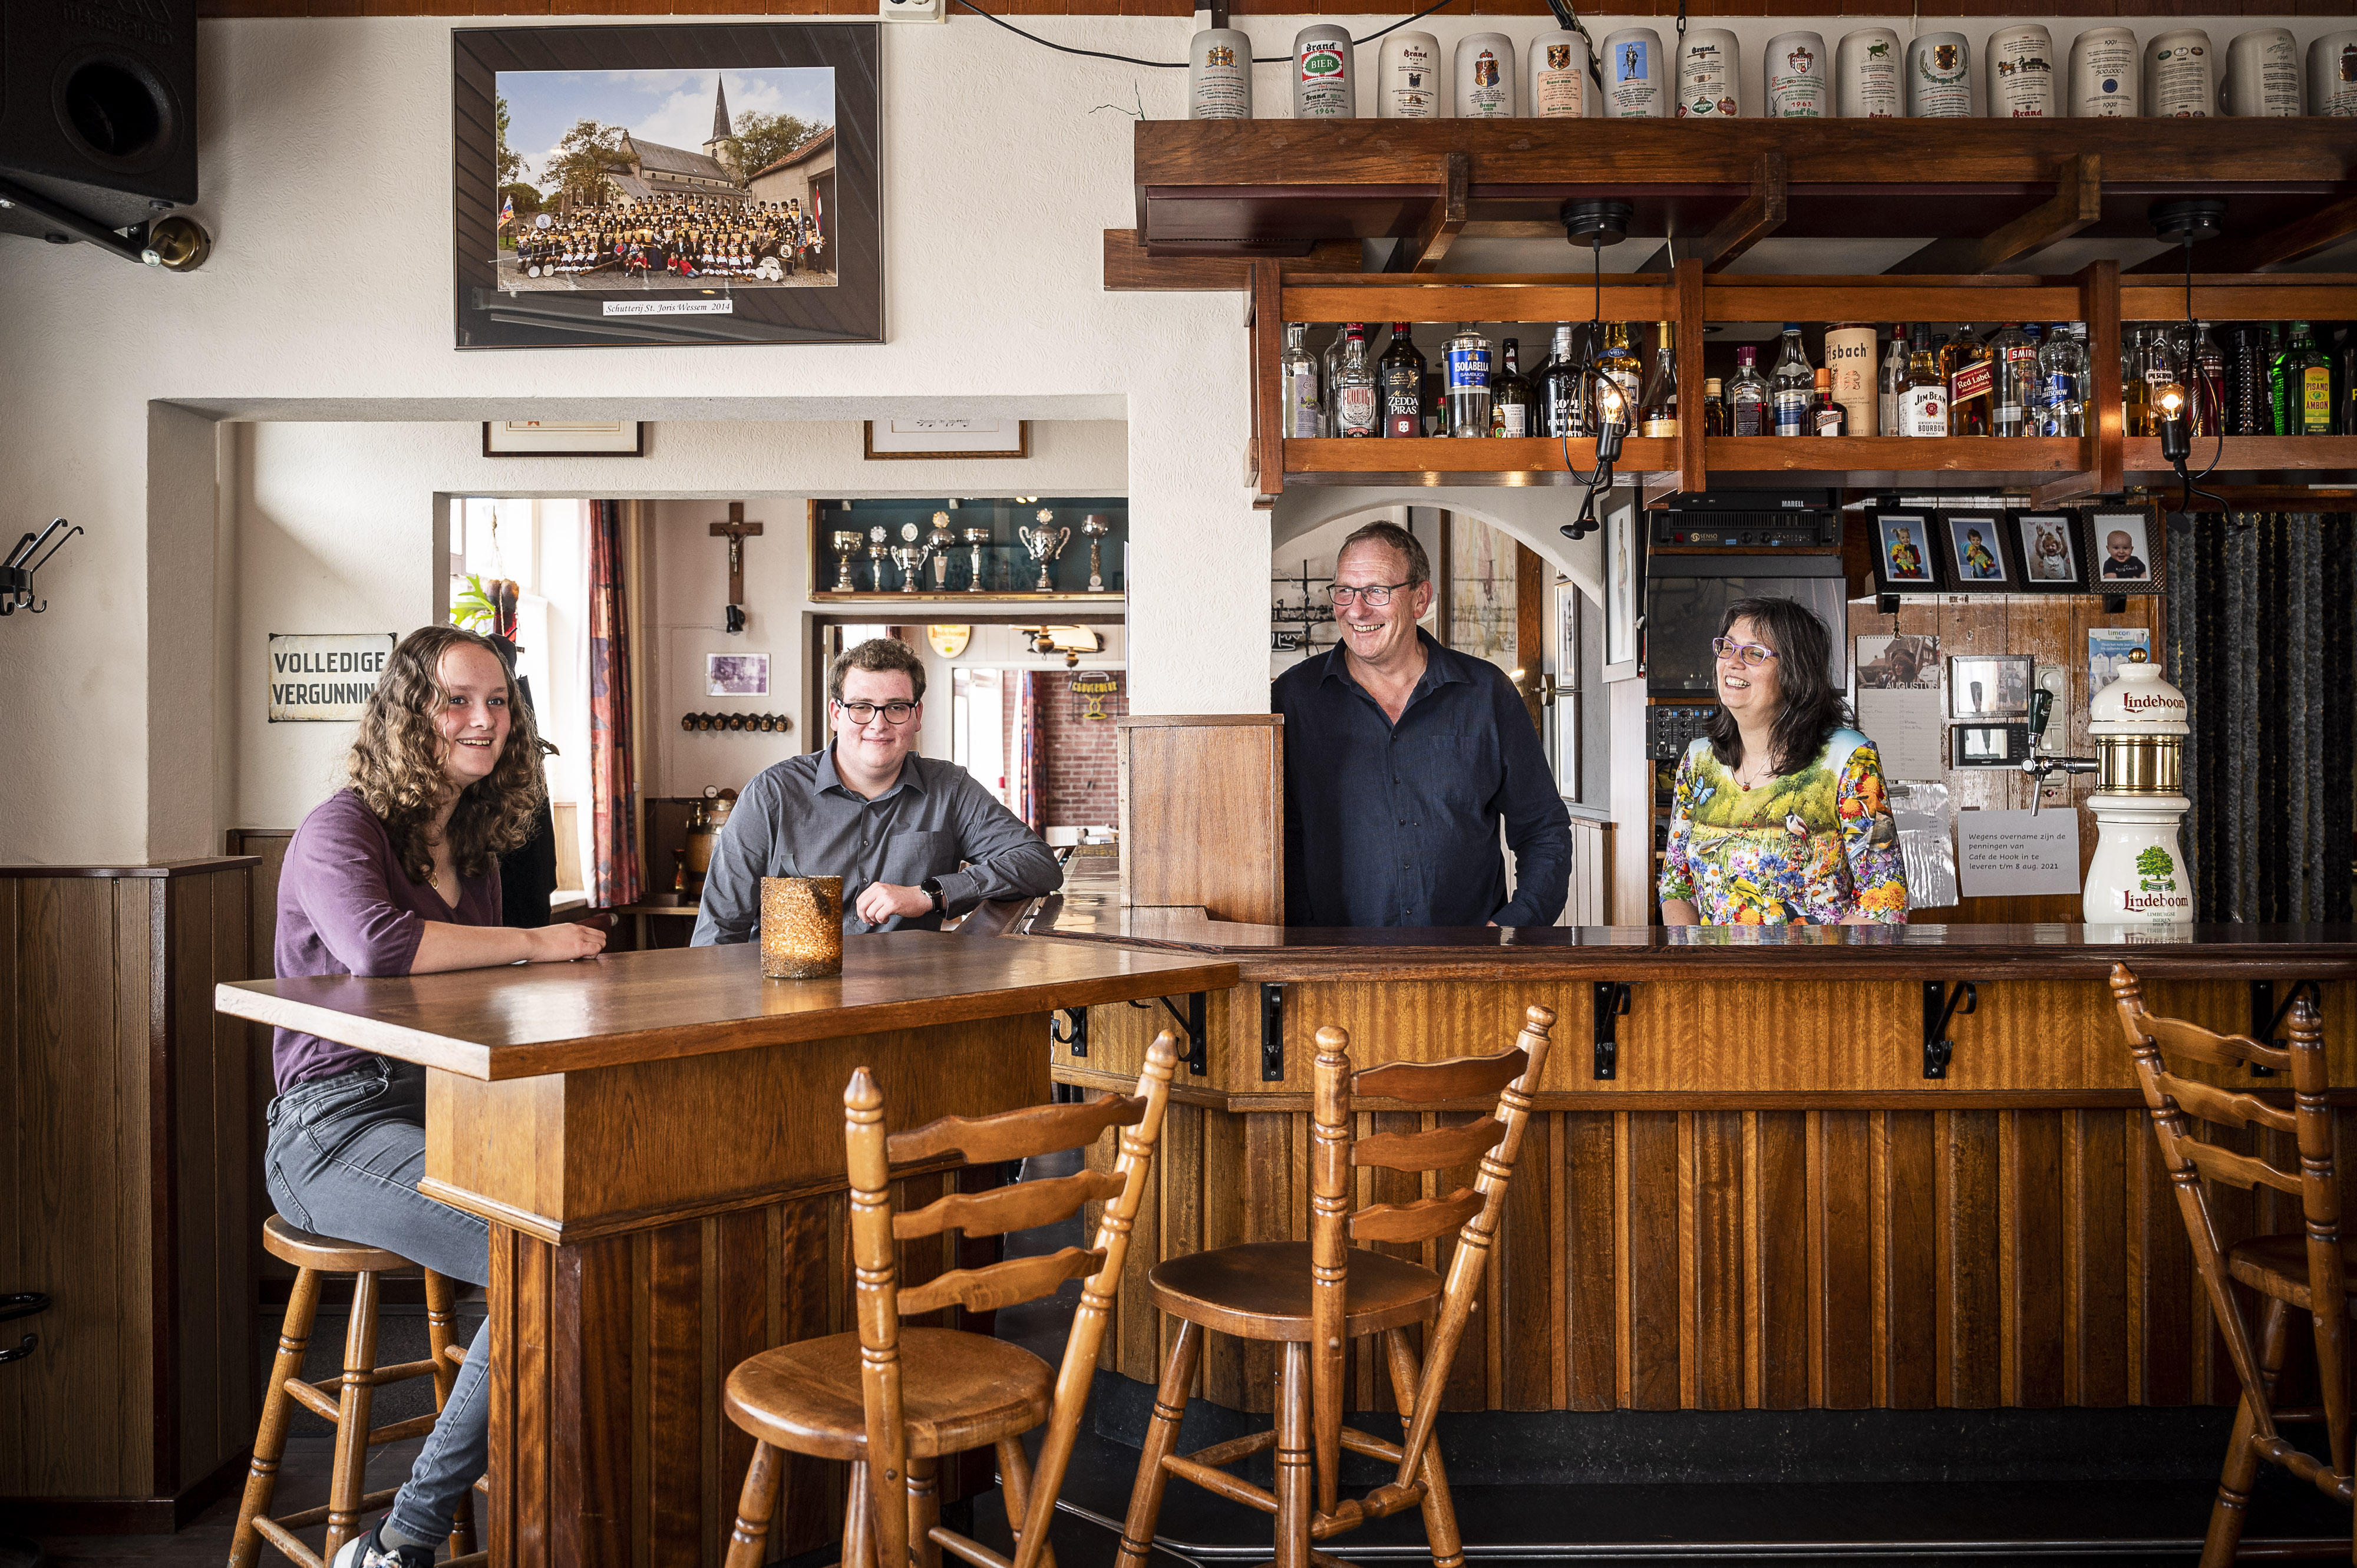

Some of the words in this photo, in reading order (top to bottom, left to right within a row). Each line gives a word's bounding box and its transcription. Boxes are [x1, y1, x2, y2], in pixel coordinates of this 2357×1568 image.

[1404, 49, 1427, 58] Brand
[1311, 60, 1333, 69] BIER
[1807, 108, 1818, 116] Bier
[2013, 109, 2042, 118] Brand
[606, 304, 643, 314] Schutterij
[645, 304, 655, 312] St.
[657, 304, 675, 313] Joris
[678, 303, 707, 311] Wessem
[711, 303, 730, 311] 2014
[1825, 341, 1867, 361] Asbach
[1454, 361, 1489, 372] ISOLABELLA
[1957, 378, 1972, 389] Red
[1972, 371, 1990, 384] Label
[2306, 383, 2328, 391] PISANG
[1388, 396, 1419, 406] ZEDDA
[1914, 394, 1929, 406] JIM
[1929, 391, 1946, 406] BEAM
[1391, 405, 1417, 415] PIRAS
[2306, 401, 2328, 410] AMBON
[274, 652, 385, 673] VOLLEDIGE
[1886, 681, 1937, 689] AUGUSTUS
[2122, 692, 2186, 714] Lindeboom
[2122, 889, 2188, 912] Lindeboom
